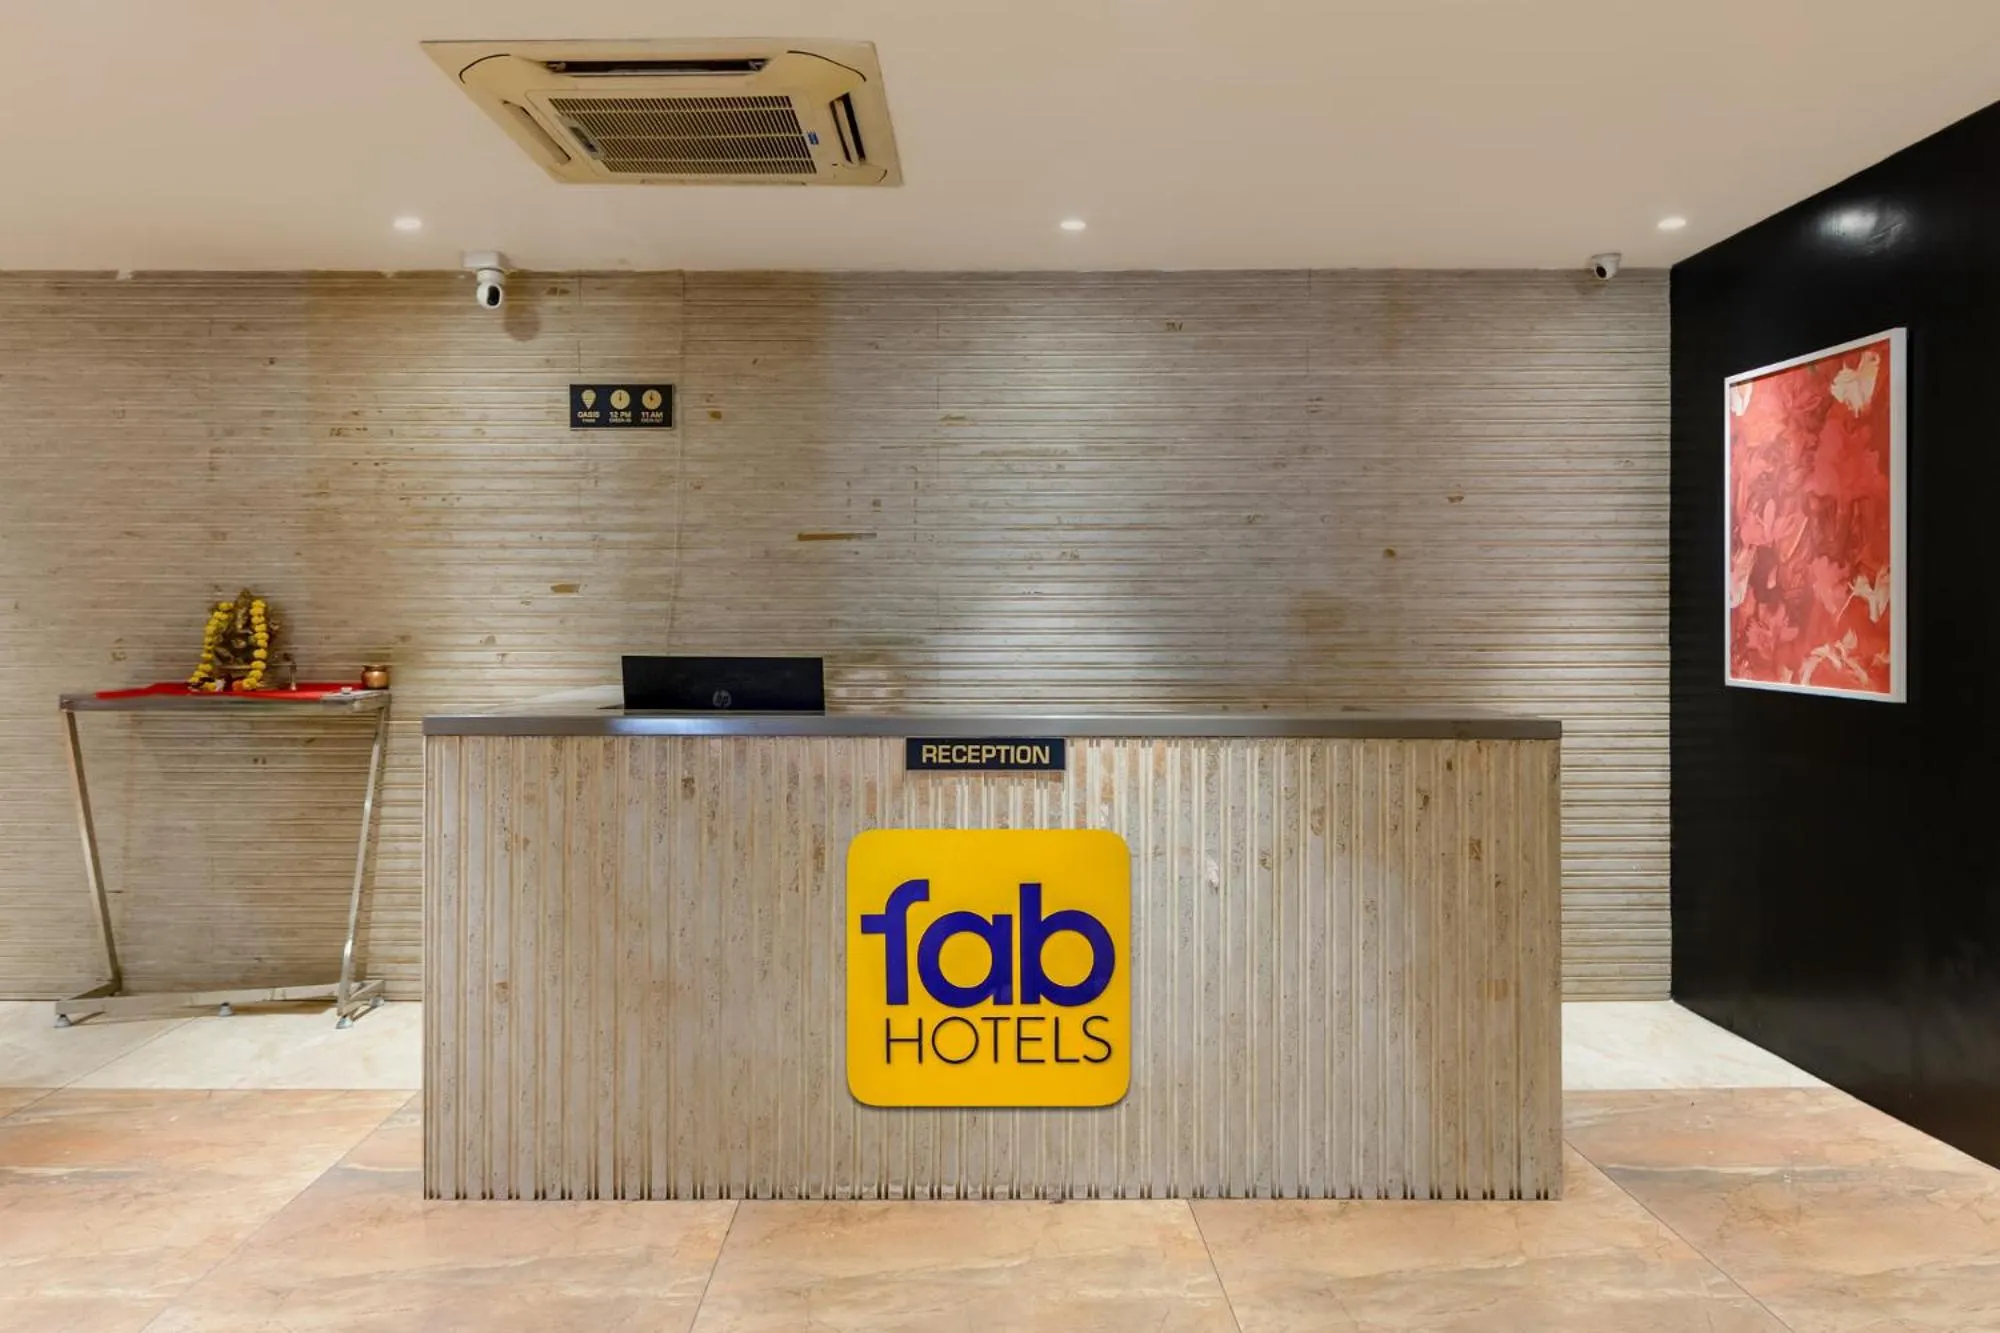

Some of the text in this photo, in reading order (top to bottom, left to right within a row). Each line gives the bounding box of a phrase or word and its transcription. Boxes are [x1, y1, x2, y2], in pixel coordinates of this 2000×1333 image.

[713, 689, 731, 708] hp
[921, 745, 1050, 764] RECEPTION
[860, 878, 1115, 1008] fab
[885, 1015, 1112, 1064] HOTELS
